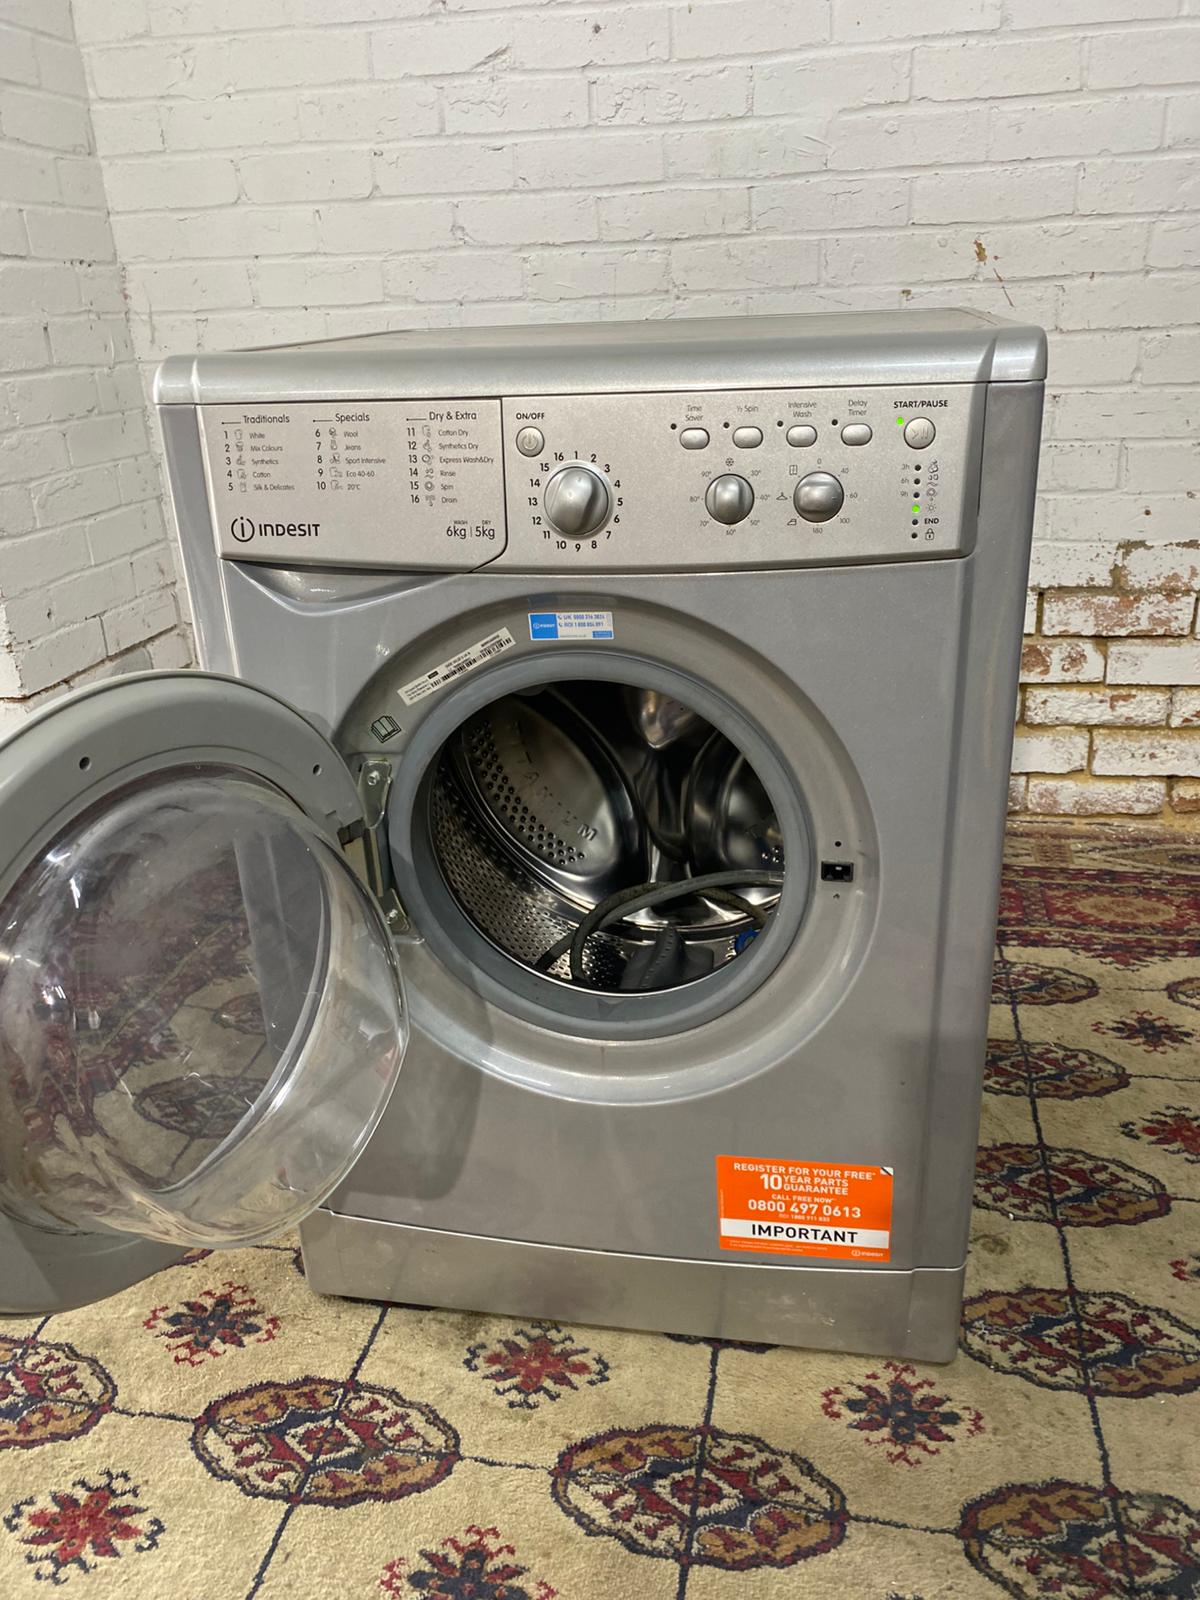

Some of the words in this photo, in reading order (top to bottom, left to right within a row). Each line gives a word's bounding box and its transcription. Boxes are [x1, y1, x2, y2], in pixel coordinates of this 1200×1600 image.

[687, 404, 702, 412] Time
[744, 405, 759, 413] Spin
[893, 400, 948, 409] START/PAUSE
[243, 413, 290, 424] Traditionals
[335, 413, 370, 424] Specials
[429, 411, 444, 422] Dry
[446, 411, 453, 420] &
[455, 411, 477, 420] Extra
[223, 431, 228, 439] 1
[315, 429, 321, 438] 6
[344, 430, 358, 438] Wool
[407, 427, 415, 437] 11
[225, 444, 230, 452] 2
[261, 444, 283, 452] Colours
[316, 441, 322, 450] 7
[408, 441, 417, 450] 12
[438, 443, 467, 451] Synthetics
[468, 443, 479, 451] Dry
[317, 455, 322, 464] 8
[409, 454, 418, 464] 13
[554, 452, 564, 461] 16
[574, 451, 578, 459] 1
[591, 454, 597, 462] 2
[225, 457, 231, 465] 3
[540, 463, 550, 472] 15
[604, 464, 610, 473] 3
[227, 470, 232, 478] 4
[318, 468, 324, 477] 9
[409, 468, 418, 477] 14
[228, 483, 233, 491] 5
[316, 481, 326, 490] 10
[410, 481, 419, 490] 15
[530, 479, 540, 487] 14
[614, 480, 621, 488] 4
[411, 494, 420, 503] 16
[528, 498, 538, 506] 13
[617, 498, 623, 506] 5
[532, 517, 542, 525] 12
[614, 515, 620, 523] 6
[447, 525, 466, 540] 6kg
[475, 526, 495, 540] 5kg
[543, 531, 551, 539] 11
[605, 531, 611, 539] 7
[556, 541, 566, 549] 10
[575, 544, 581, 552] 9
[733, 1162, 785, 1174] REGISTER
[788, 1167, 810, 1176] FOR
[812, 1168, 841, 1178] YOUR
[760, 1174, 782, 1190] 10
[784, 1175, 810, 1185] YEAR
[814, 1178, 849, 1187] PARTS
[784, 1183, 849, 1196] GUARANTEE
[771, 1193, 790, 1201] CALL
[792, 1195, 812, 1203] FREE
[748, 1199, 786, 1213] 0800
[790, 1202, 818, 1215] 497
[822, 1205, 861, 1218] 0613
[752, 1223, 858, 1243] IMPORTANT
